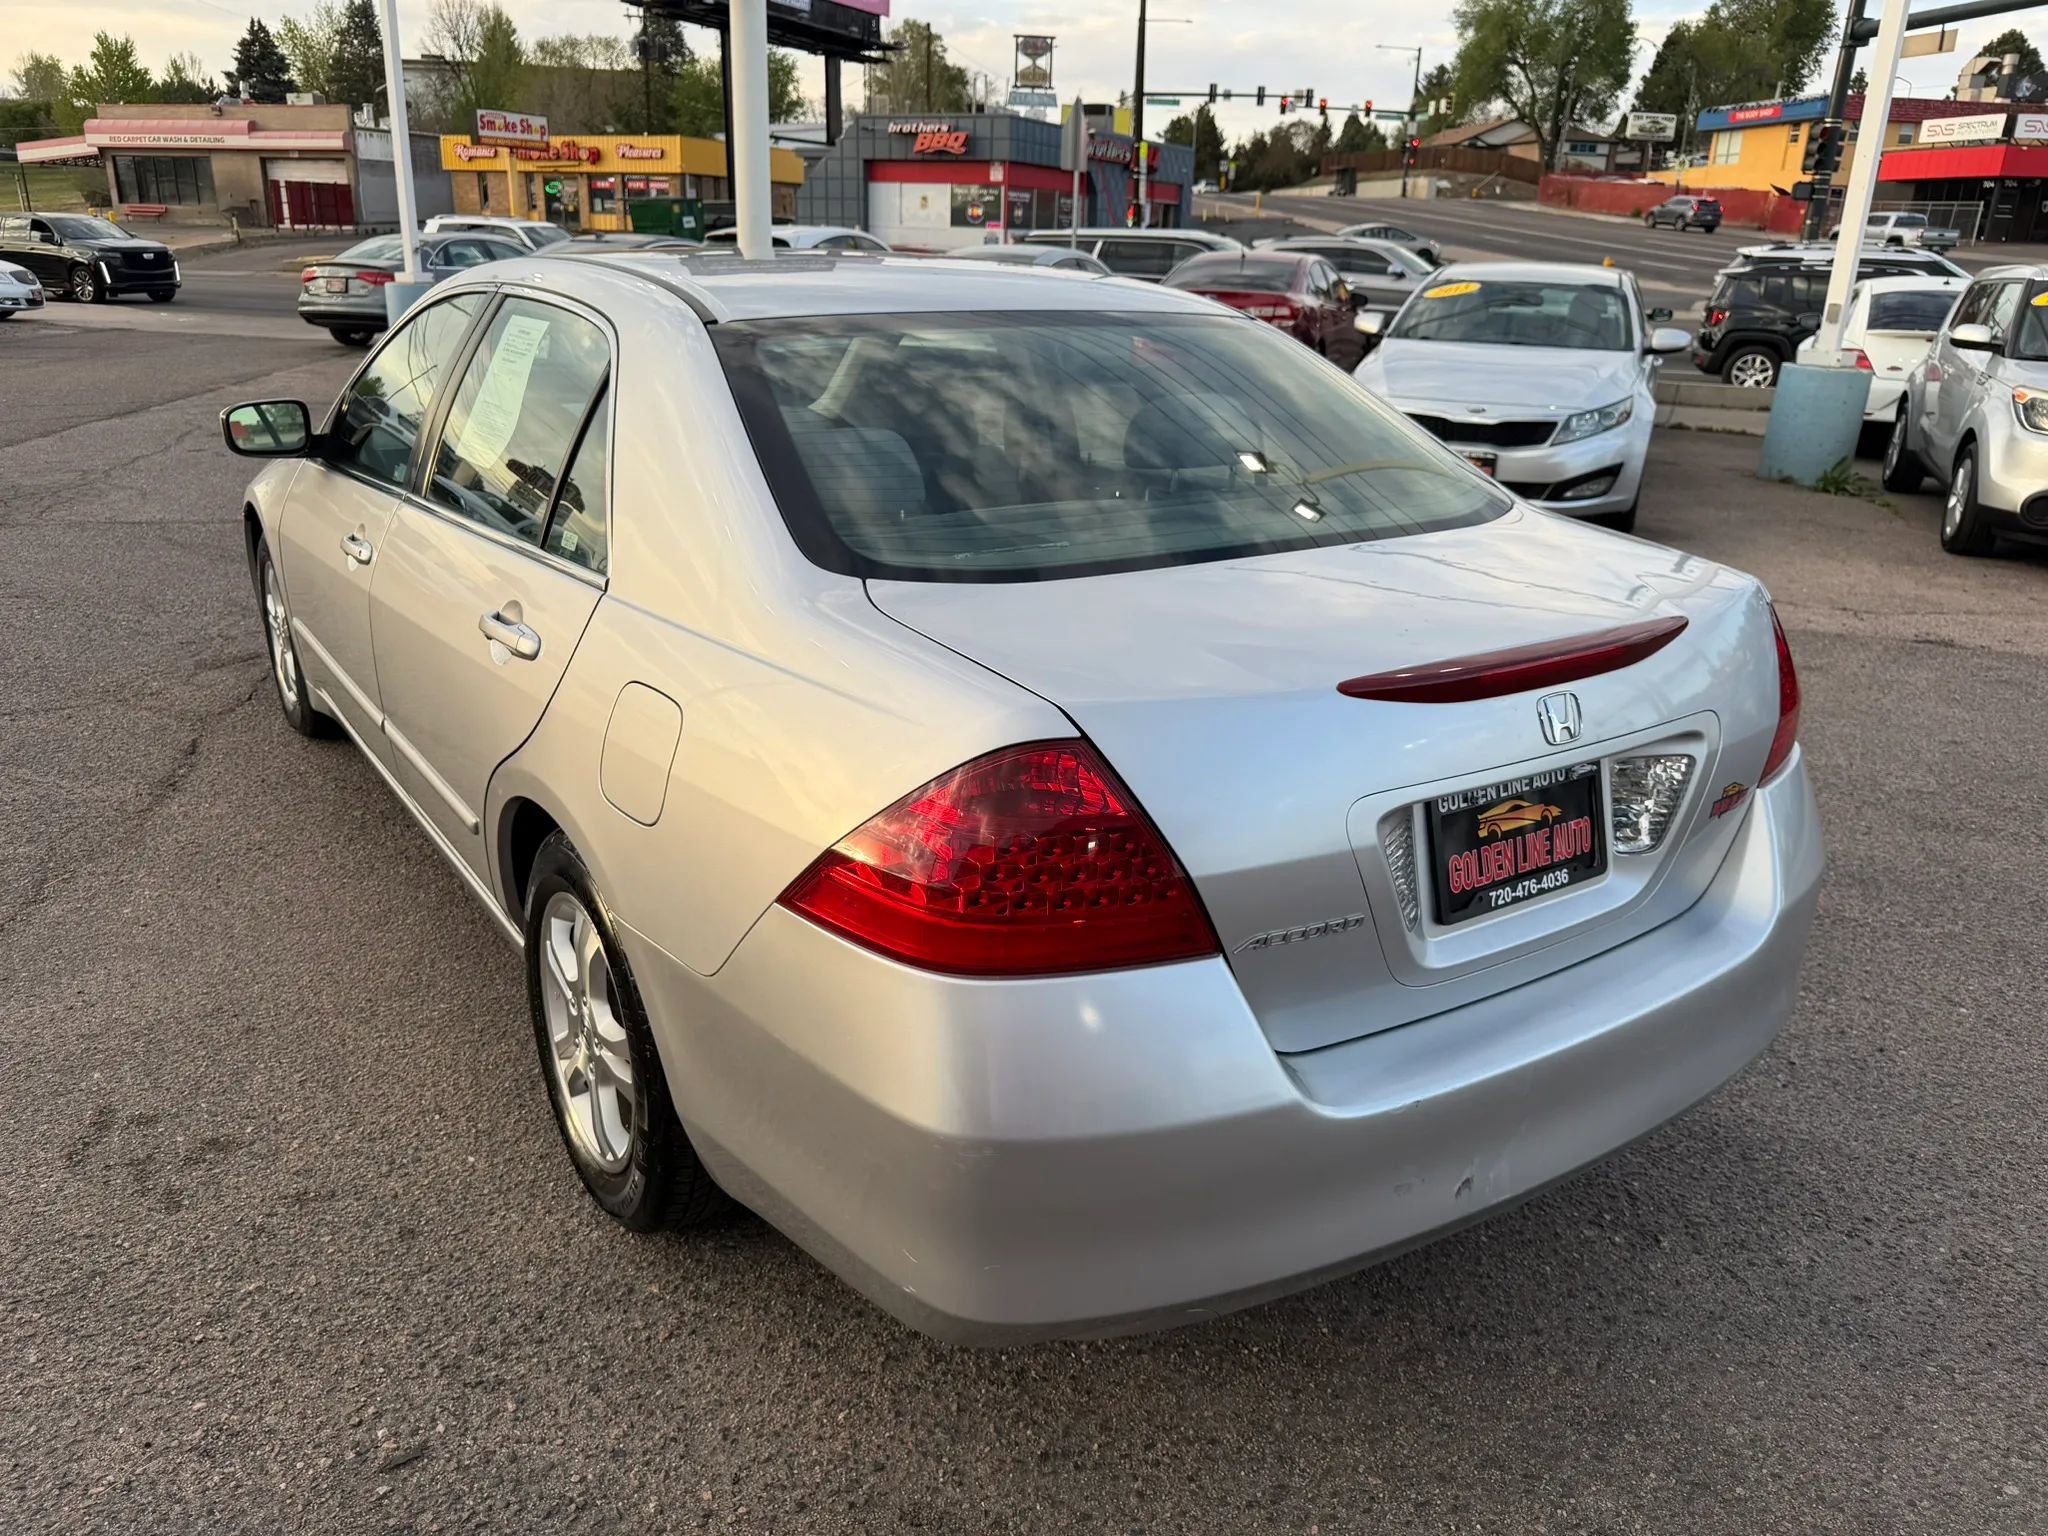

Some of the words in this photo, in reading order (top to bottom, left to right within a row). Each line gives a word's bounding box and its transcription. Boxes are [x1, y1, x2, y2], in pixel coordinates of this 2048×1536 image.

[479, 114, 518, 133] Smoke
[519, 118, 546, 140] Shop
[887, 121, 950, 134] brothers
[1957, 120, 1998, 130] SPECTRUM
[122, 135, 147, 144] CARPET
[148, 136, 161, 144] CAR
[162, 136, 183, 144] WASH
[190, 136, 225, 145] DETAILING
[454, 144, 496, 161] Romance
[559, 140, 601, 164] Shop
[616, 143, 664, 160] Pleasures
[912, 131, 970, 155] BBQ
[1500, 779, 1530, 798] LINE
[1532, 768, 1566, 789] AUTO
[1448, 838, 1515, 894] GOLDEN
[1517, 827, 1551, 874] LINE
[1553, 815, 1592, 863] AUTO
[1488, 867, 1569, 908] 720-476-4036
[1232, 911, 1365, 955] ACCORD
